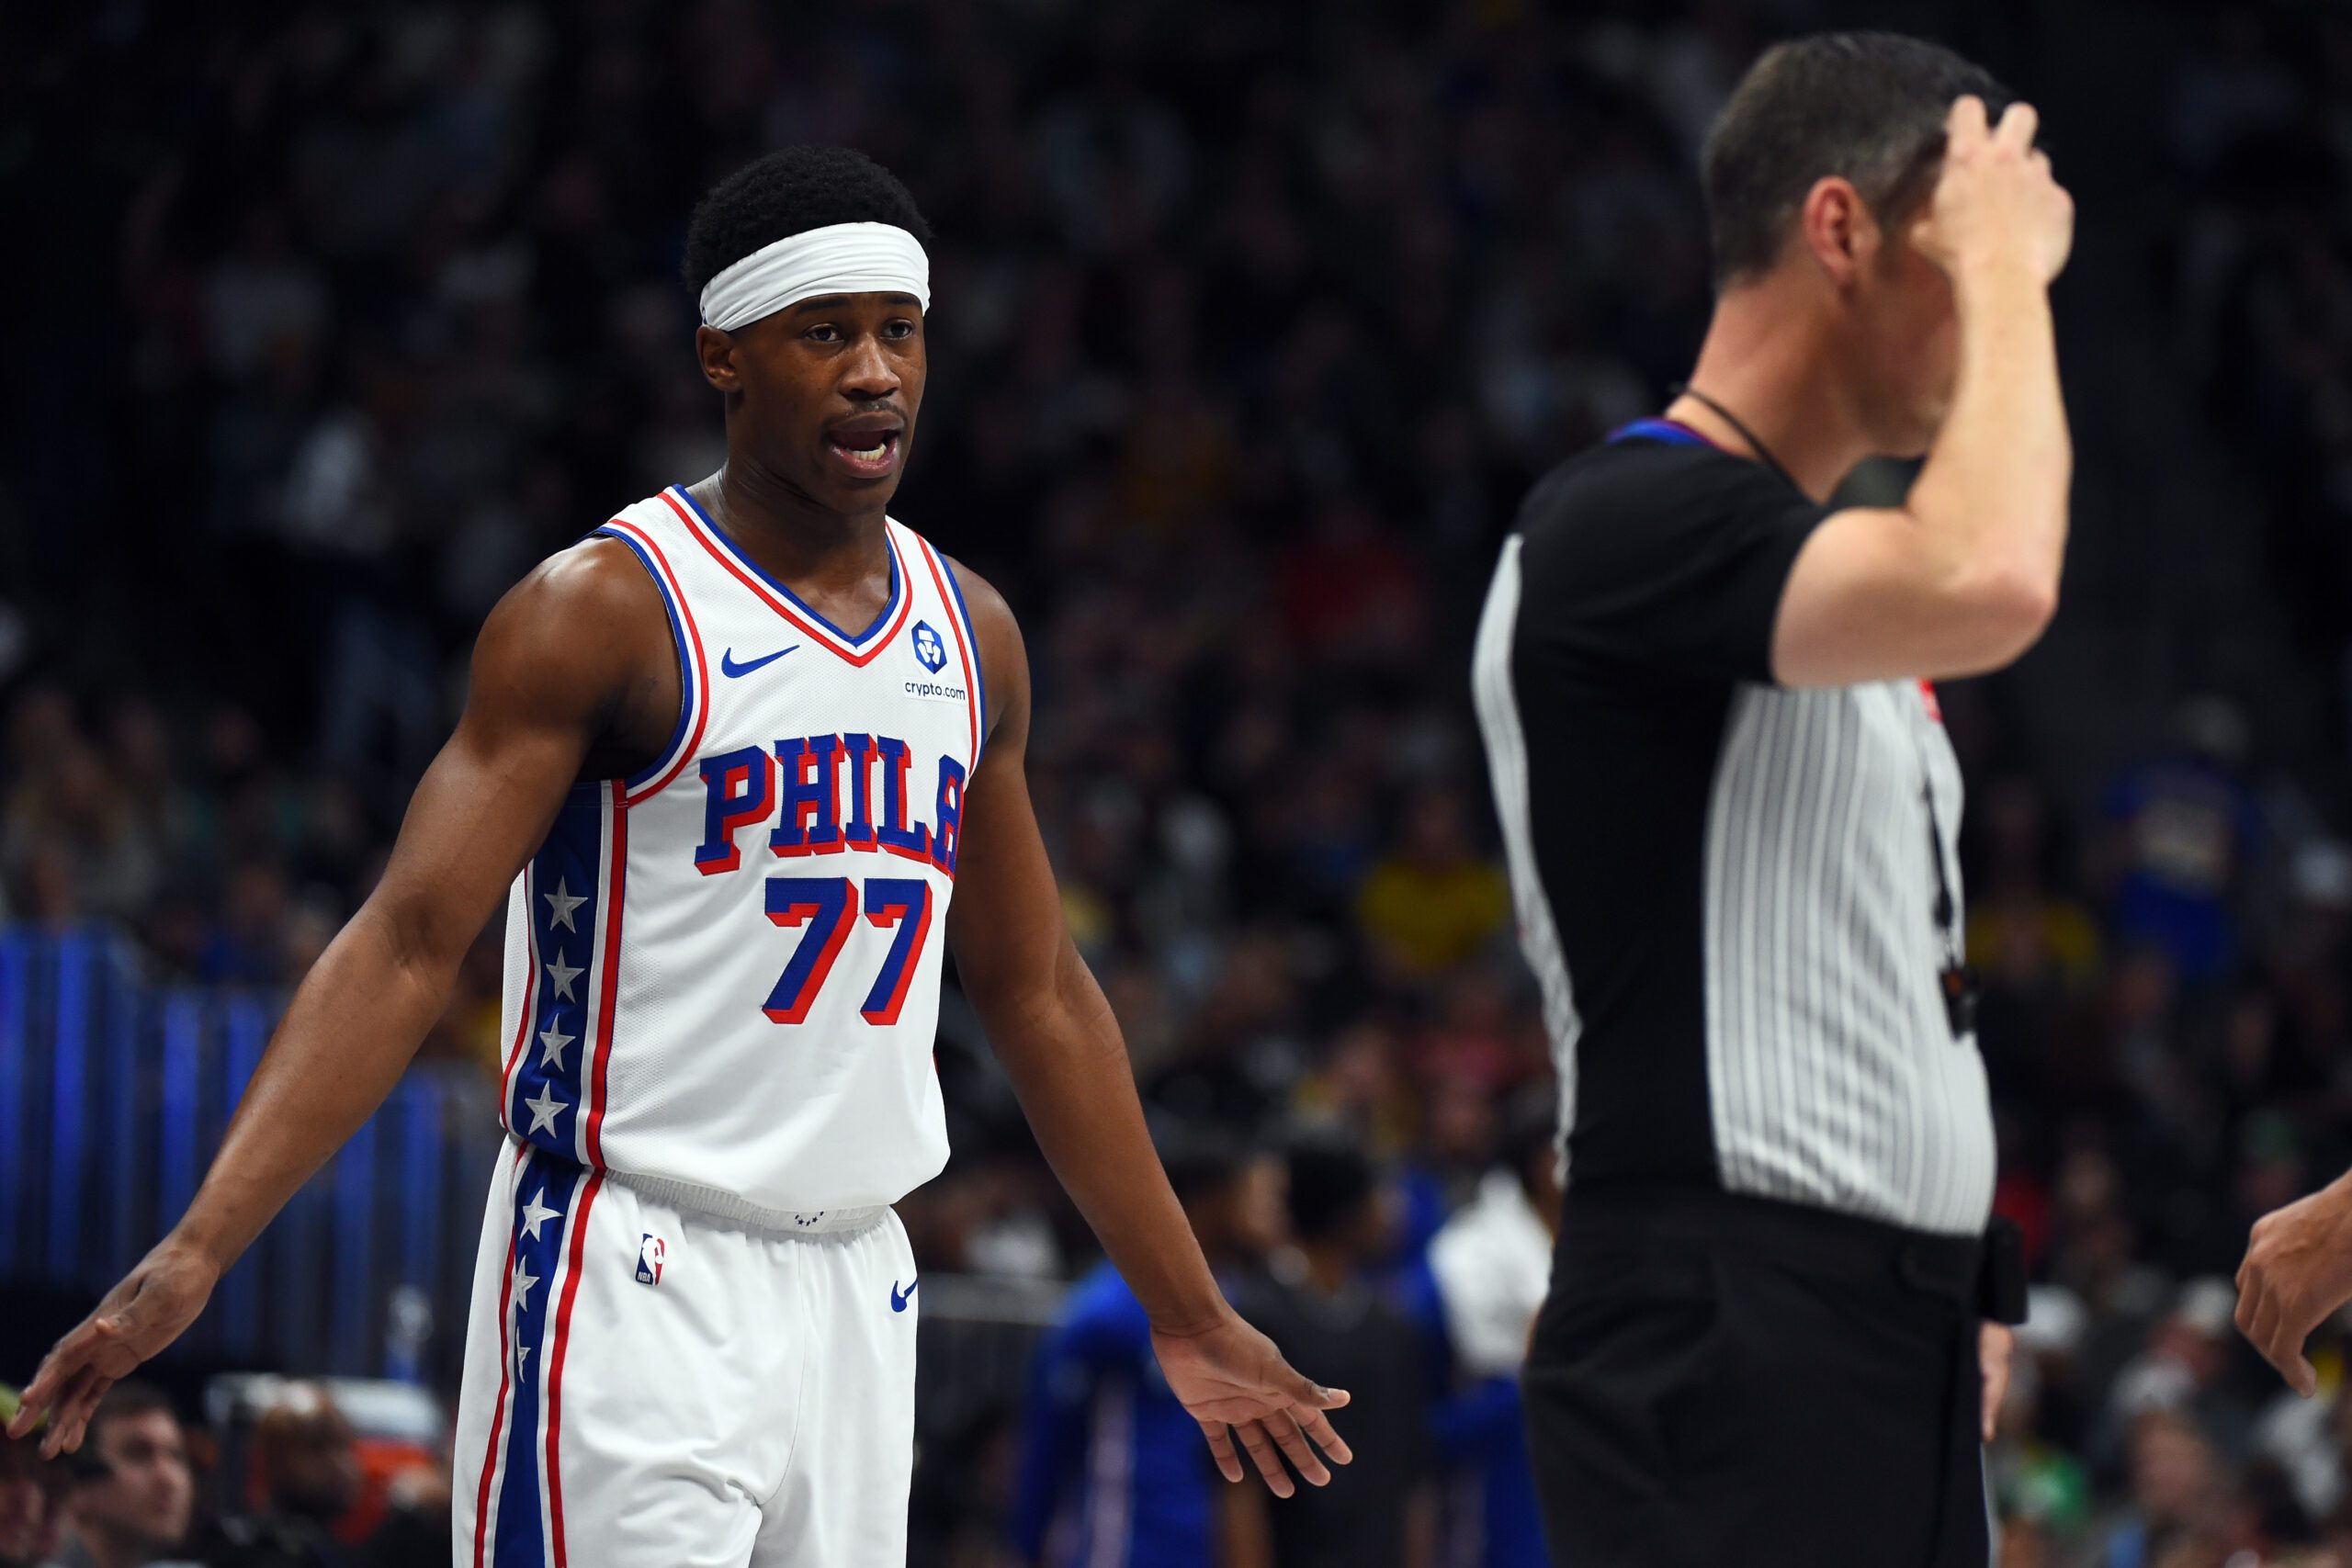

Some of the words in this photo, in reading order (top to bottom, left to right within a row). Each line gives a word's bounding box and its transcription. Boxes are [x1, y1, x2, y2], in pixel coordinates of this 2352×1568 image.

[904, 682, 967, 701] crypto.com
[694, 731, 966, 881] PHILA
[762, 876, 933, 1025] 77
[637, 1270, 651, 1283] NBA
